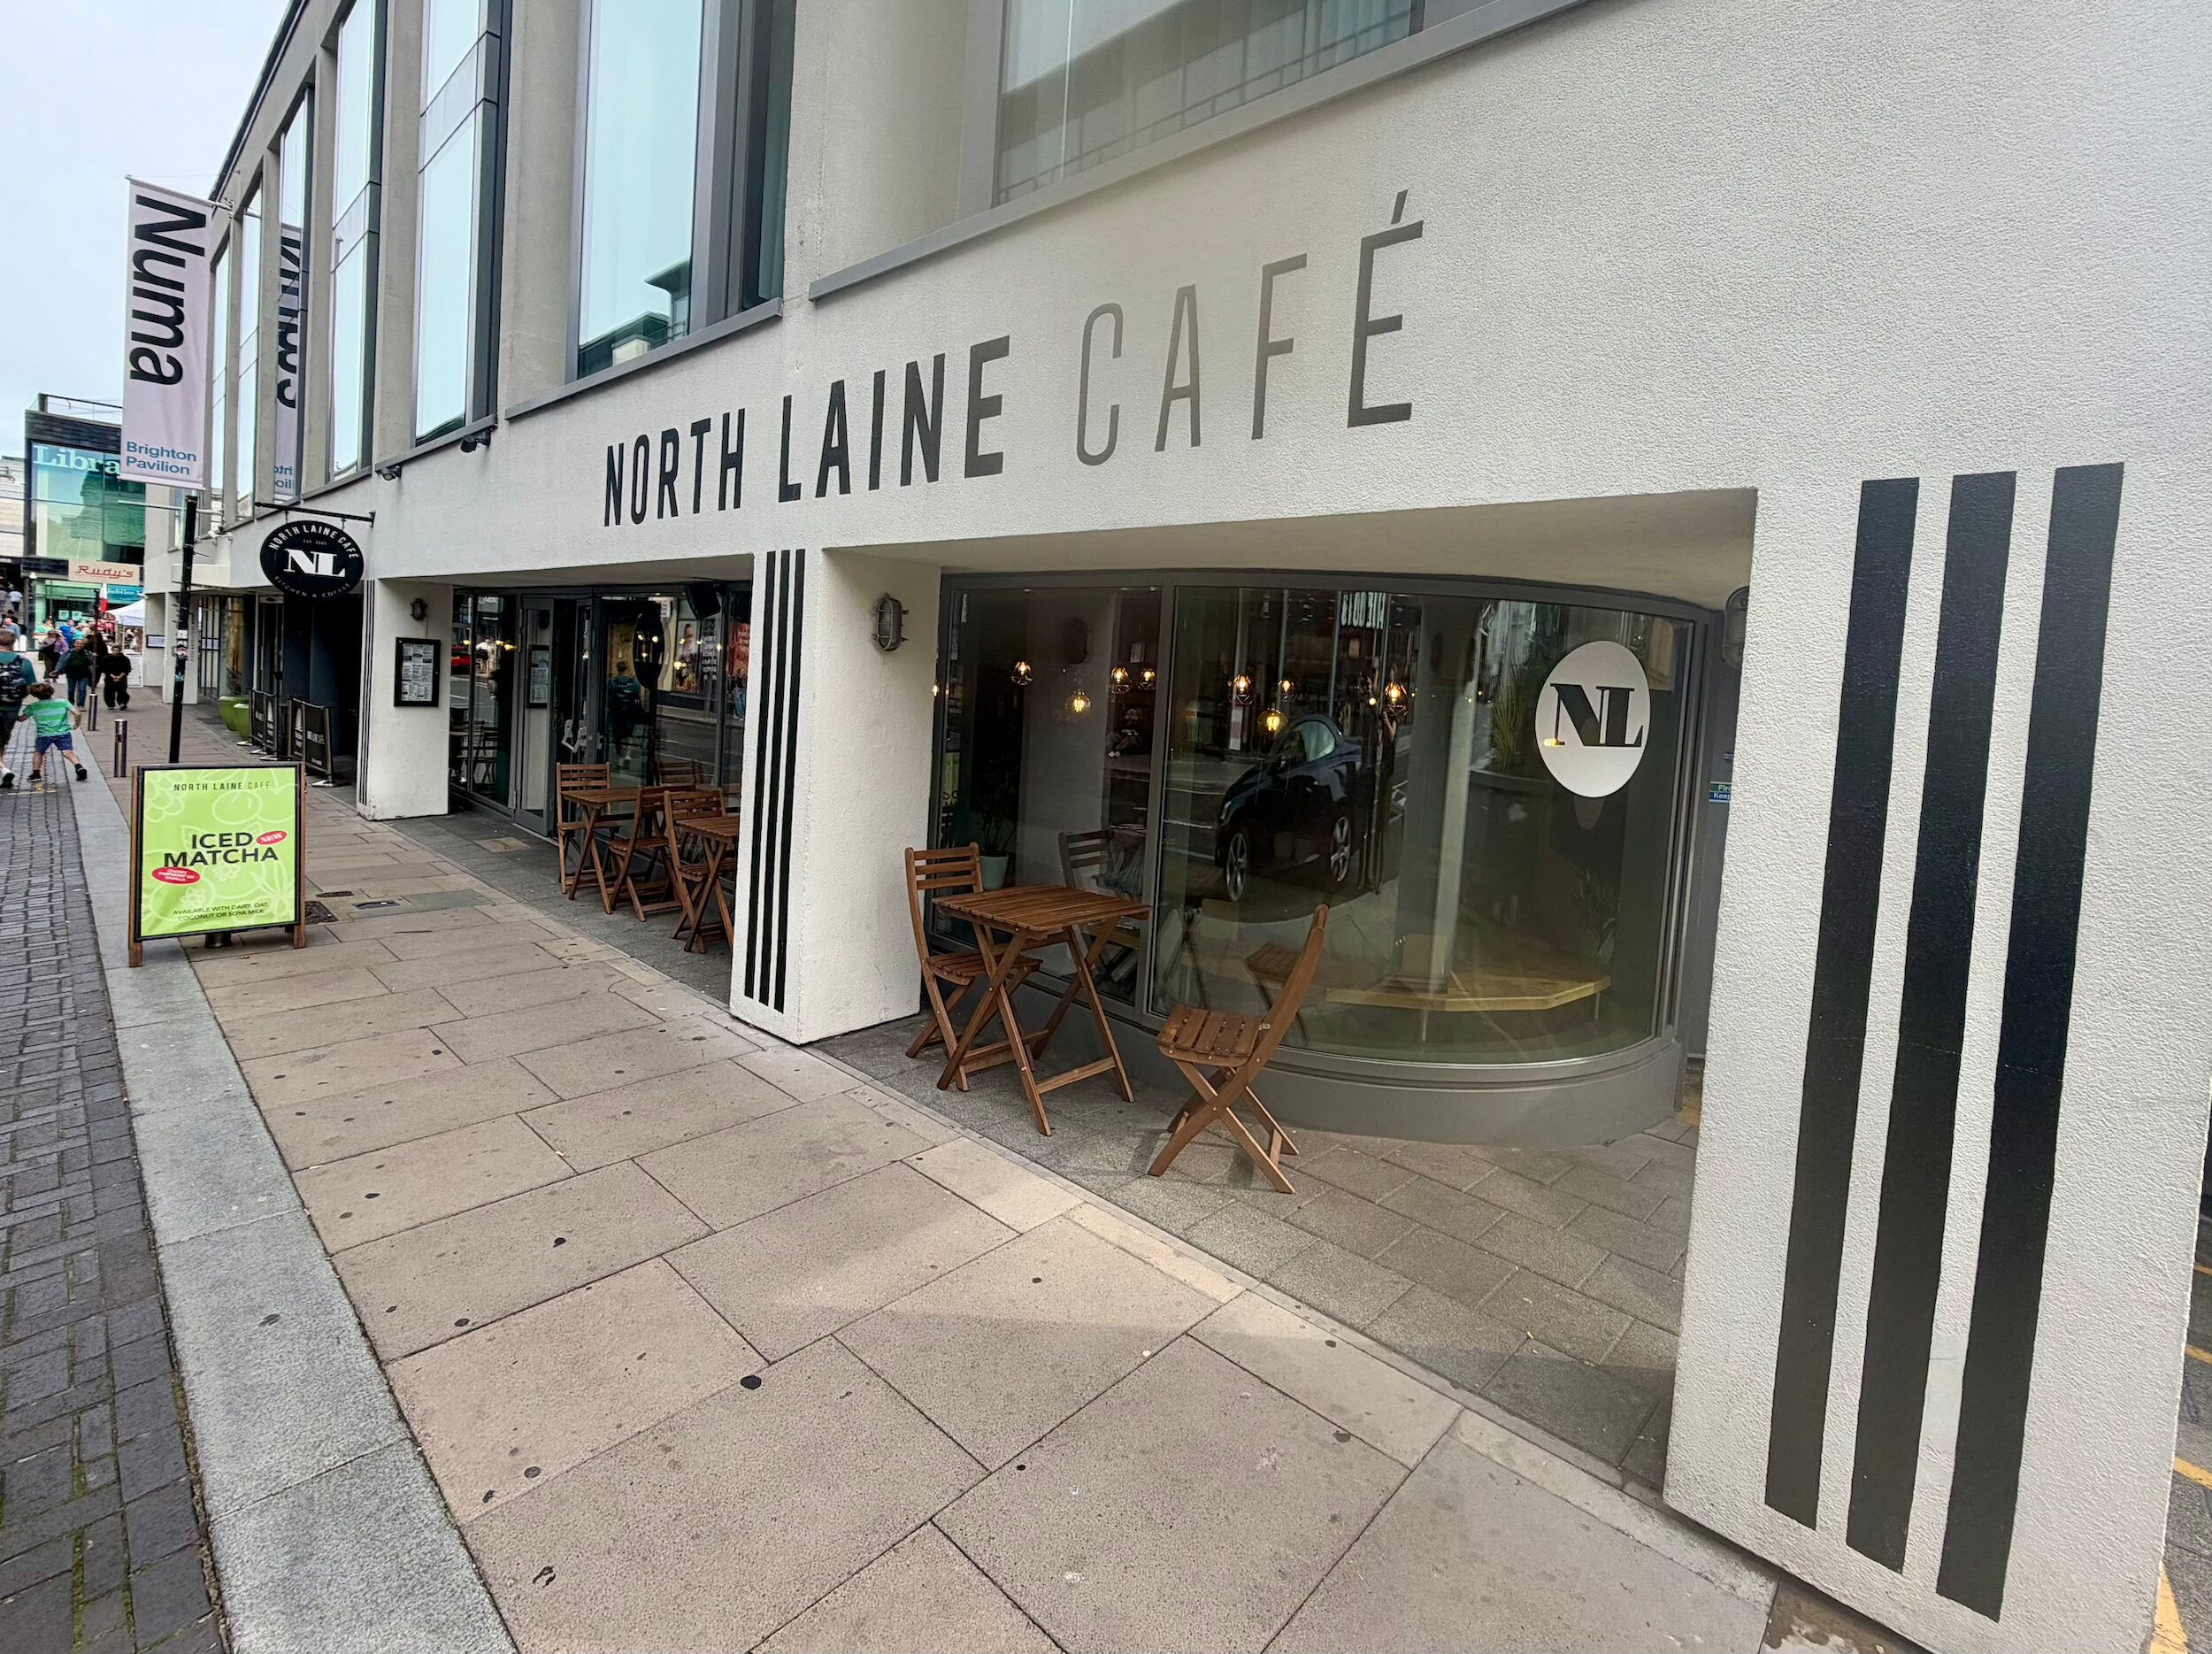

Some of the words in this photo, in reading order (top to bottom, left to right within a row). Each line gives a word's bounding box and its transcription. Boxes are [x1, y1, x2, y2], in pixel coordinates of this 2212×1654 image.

[129, 194, 207, 387] Numa
[604, 408, 746, 527] NORTH
[778, 335, 1010, 503] LAINE
[1076, 189, 1425, 466] CAFÉ
[127, 442, 197, 462] Brighton
[127, 456, 190, 475] Pavilion
[268, 526, 300, 550] NORTH
[303, 525, 338, 539] LAINE
[75, 565, 134, 580] Rudy's
[283, 548, 346, 578] NL
[1549, 682, 1645, 748] NL
[191, 832, 253, 850] ICED
[164, 847, 279, 867] MATCHA
[173, 905, 211, 915] AVAILABLE
[178, 912, 215, 922] COCONUT
